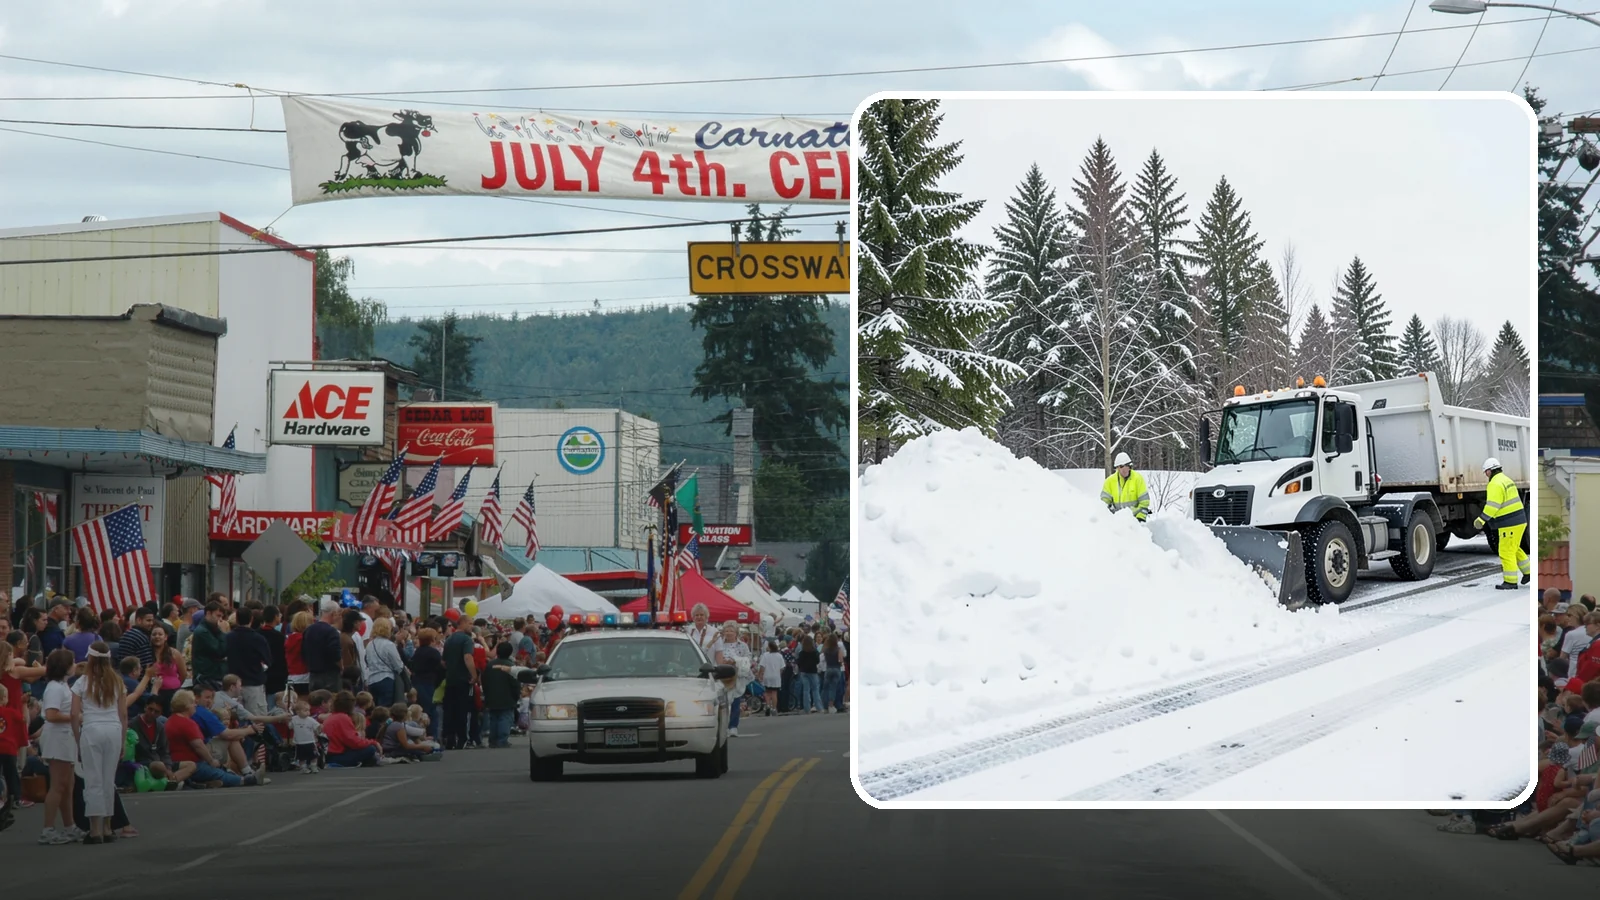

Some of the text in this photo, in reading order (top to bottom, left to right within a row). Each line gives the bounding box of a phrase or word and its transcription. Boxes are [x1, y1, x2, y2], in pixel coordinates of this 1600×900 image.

[694, 121, 850, 150] Carnat
[481, 141, 605, 192] JULY
[632, 150, 746, 198] 4th.
[697, 254, 850, 280] CROSSWA
[282, 380, 374, 420] ACE
[405, 409, 453, 422] CEDAR
[283, 421, 371, 436] Hardware
[416, 428, 477, 447] Coca-Cola
[353, 467, 383, 481] Simpl
[83, 485, 155, 495] St. Vincent de Paul
[348, 479, 378, 488] GRA
[81, 503, 154, 522] THRT
[688, 526, 741, 535] CRNATION
[699, 535, 730, 543] GLASS
